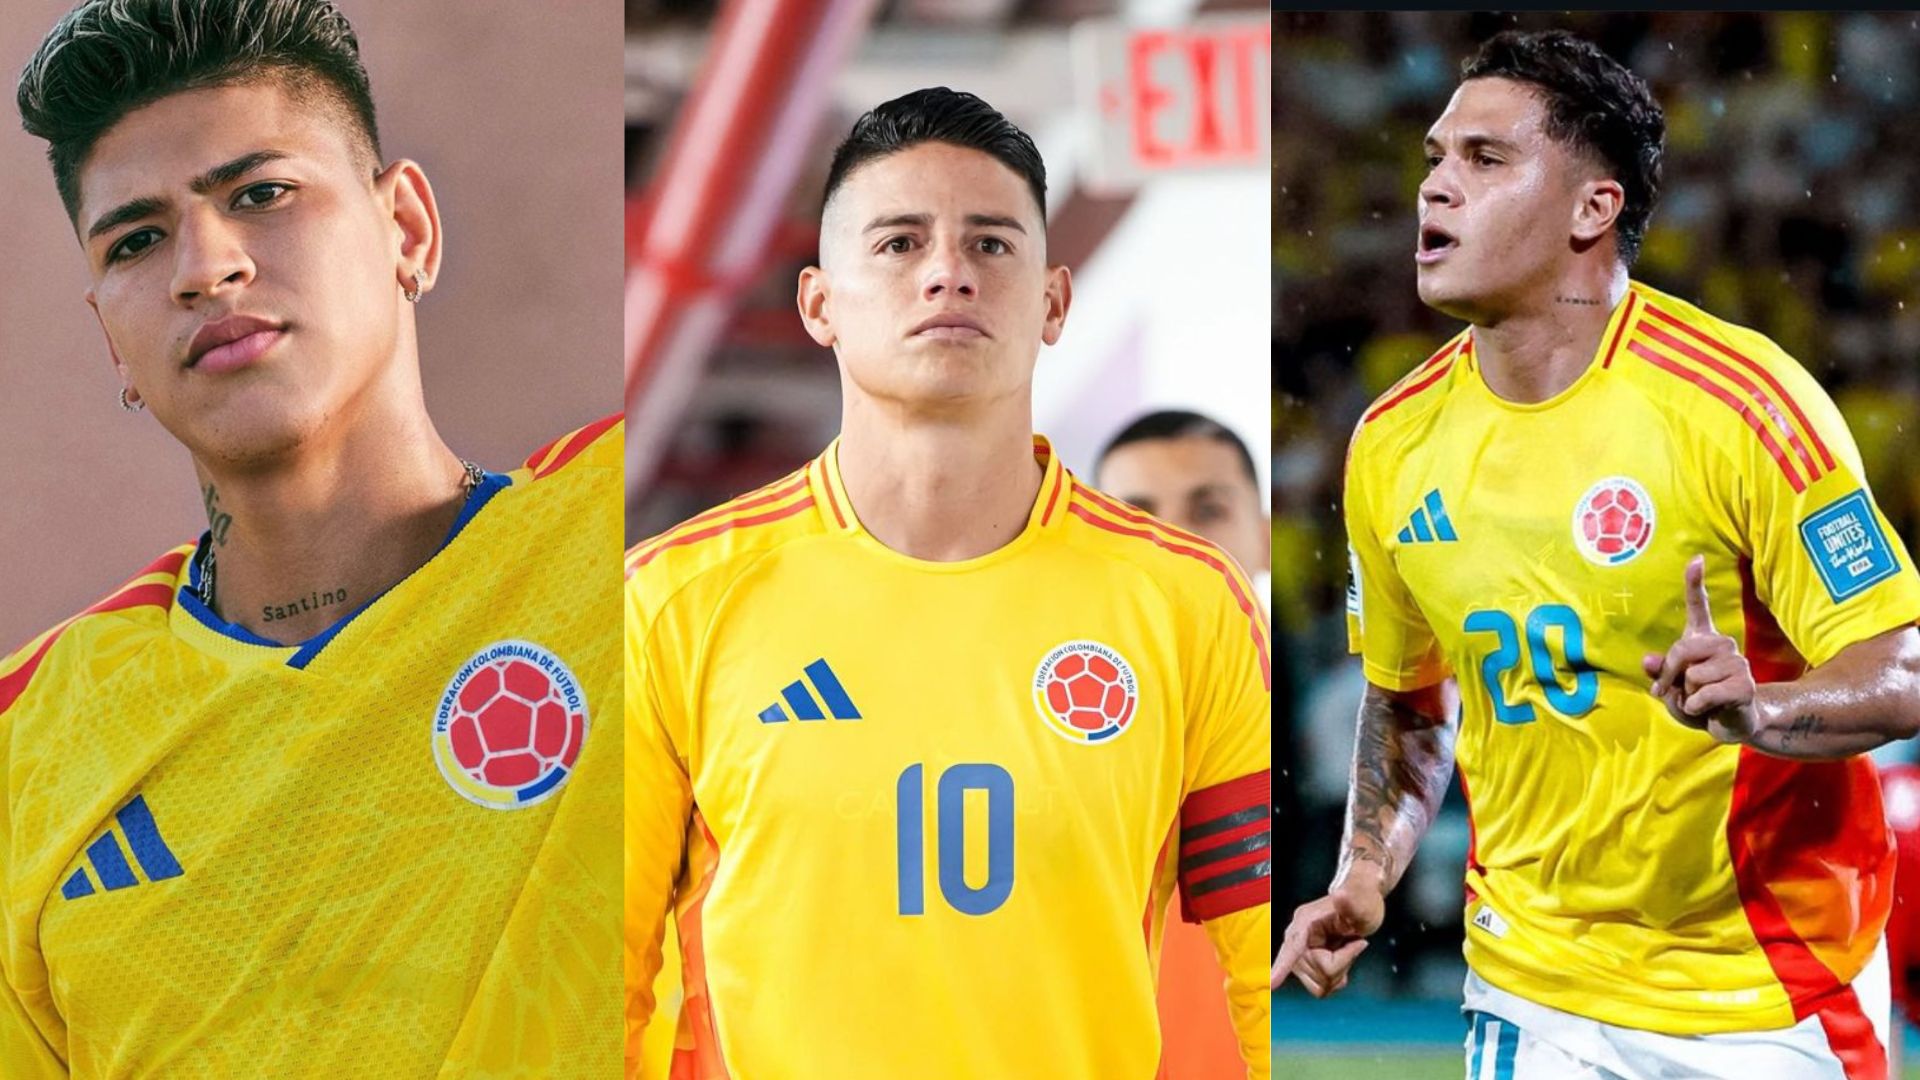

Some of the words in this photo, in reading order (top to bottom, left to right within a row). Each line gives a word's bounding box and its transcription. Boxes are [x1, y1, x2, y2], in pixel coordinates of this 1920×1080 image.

[1130, 28, 1270, 166] EXI
[1823, 522, 1866, 554] UNITES
[262, 588, 347, 622] Santino
[473, 645, 539, 669] COLOMBIANA
[539, 655, 554, 671] DE
[1464, 604, 1598, 725] 20
[897, 762, 1015, 916] 10
